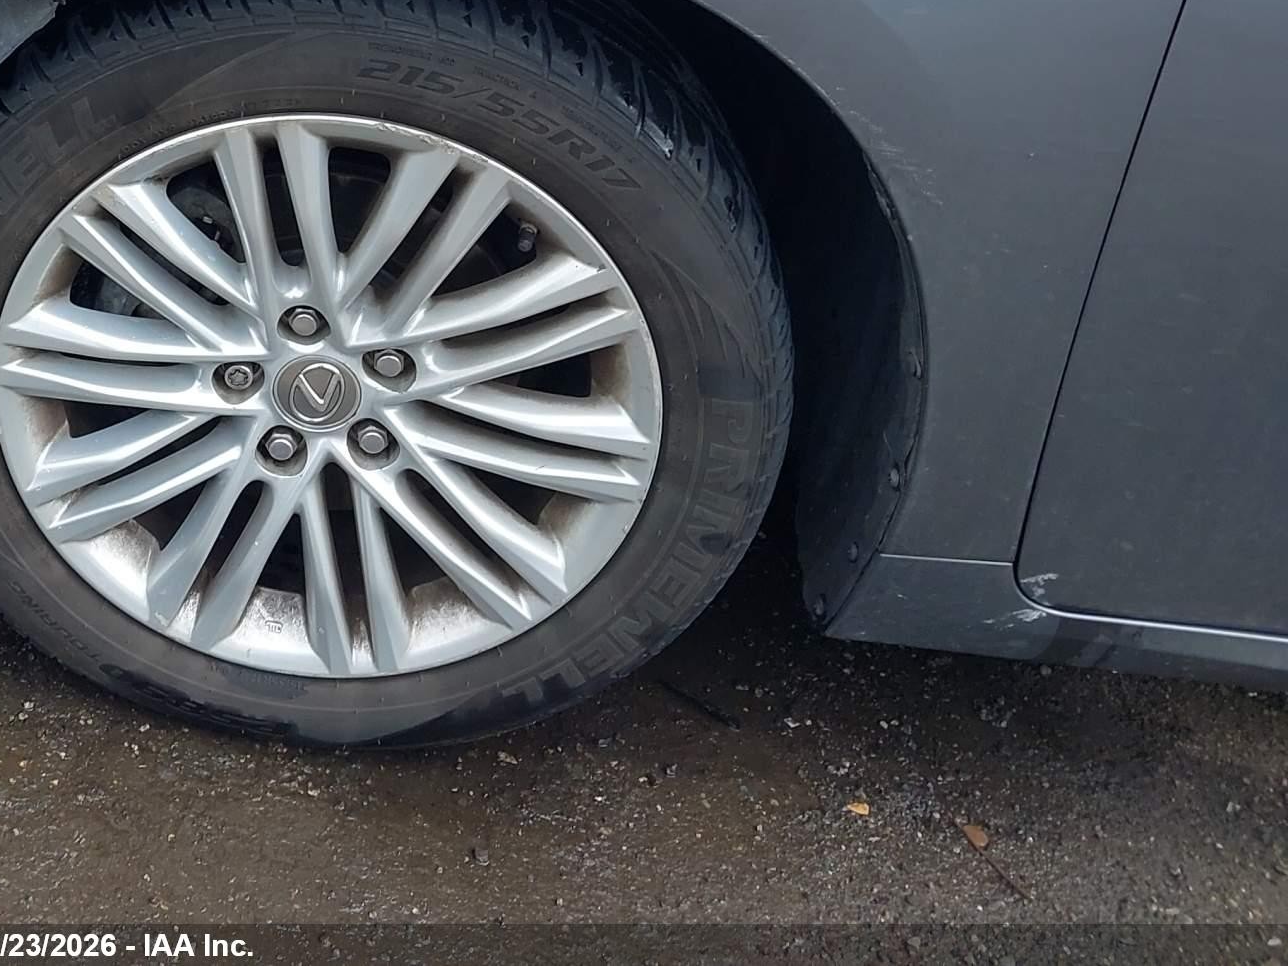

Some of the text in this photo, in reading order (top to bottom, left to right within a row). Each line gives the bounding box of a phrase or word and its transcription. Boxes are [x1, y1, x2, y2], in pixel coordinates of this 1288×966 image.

[355, 57, 642, 191] 215/55R17
[502, 397, 759, 703] PRIMEWELL
[8, 580, 102, 662] TOURING
